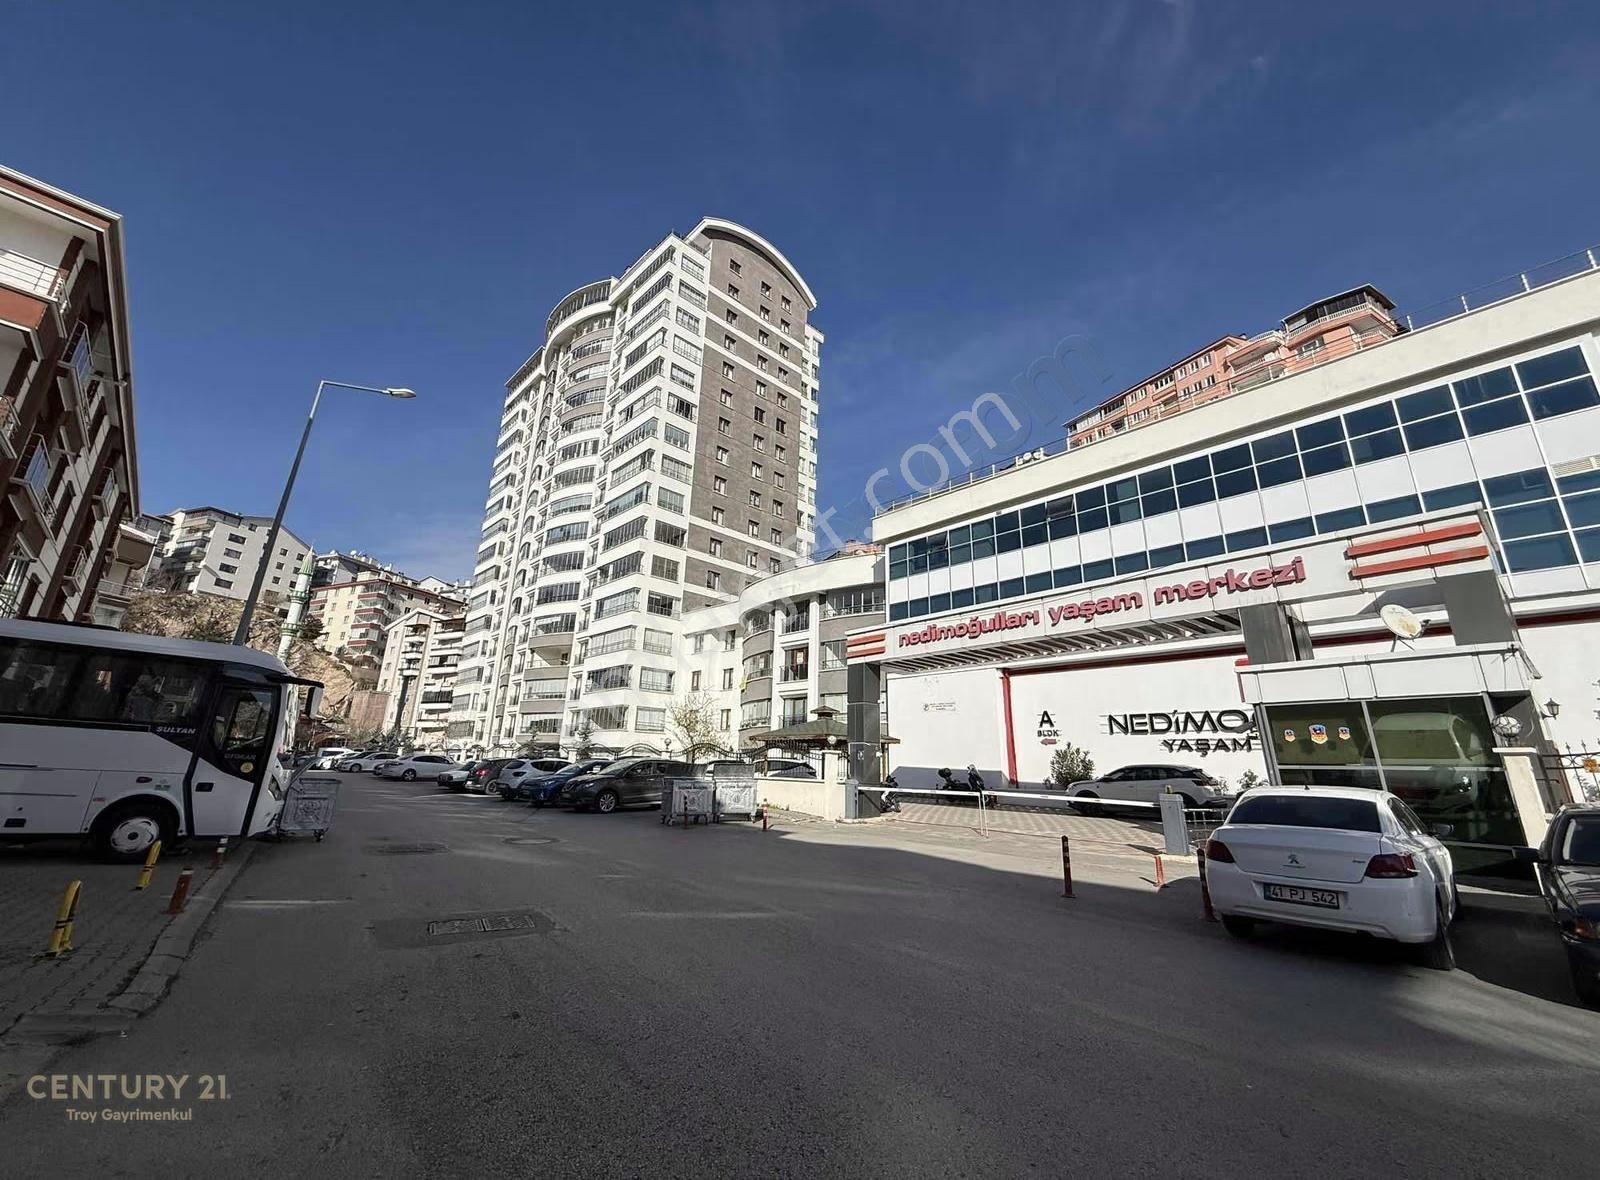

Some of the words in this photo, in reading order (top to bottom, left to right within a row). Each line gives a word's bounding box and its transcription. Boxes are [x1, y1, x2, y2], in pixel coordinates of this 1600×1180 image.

[899, 607, 1040, 647] nedimoğulları
[1048, 588, 1143, 626] yaşam
[1154, 556, 1308, 606] merkezi
[1039, 711, 1055, 728] A
[1108, 709, 1257, 736] NEDİMO
[156, 726, 197, 734] SULTAN
[1161, 738, 1251, 757] YAŞAM
[1271, 886, 1283, 898] 41
[1289, 888, 1306, 900] PJ
[1311, 891, 1336, 905] 542
